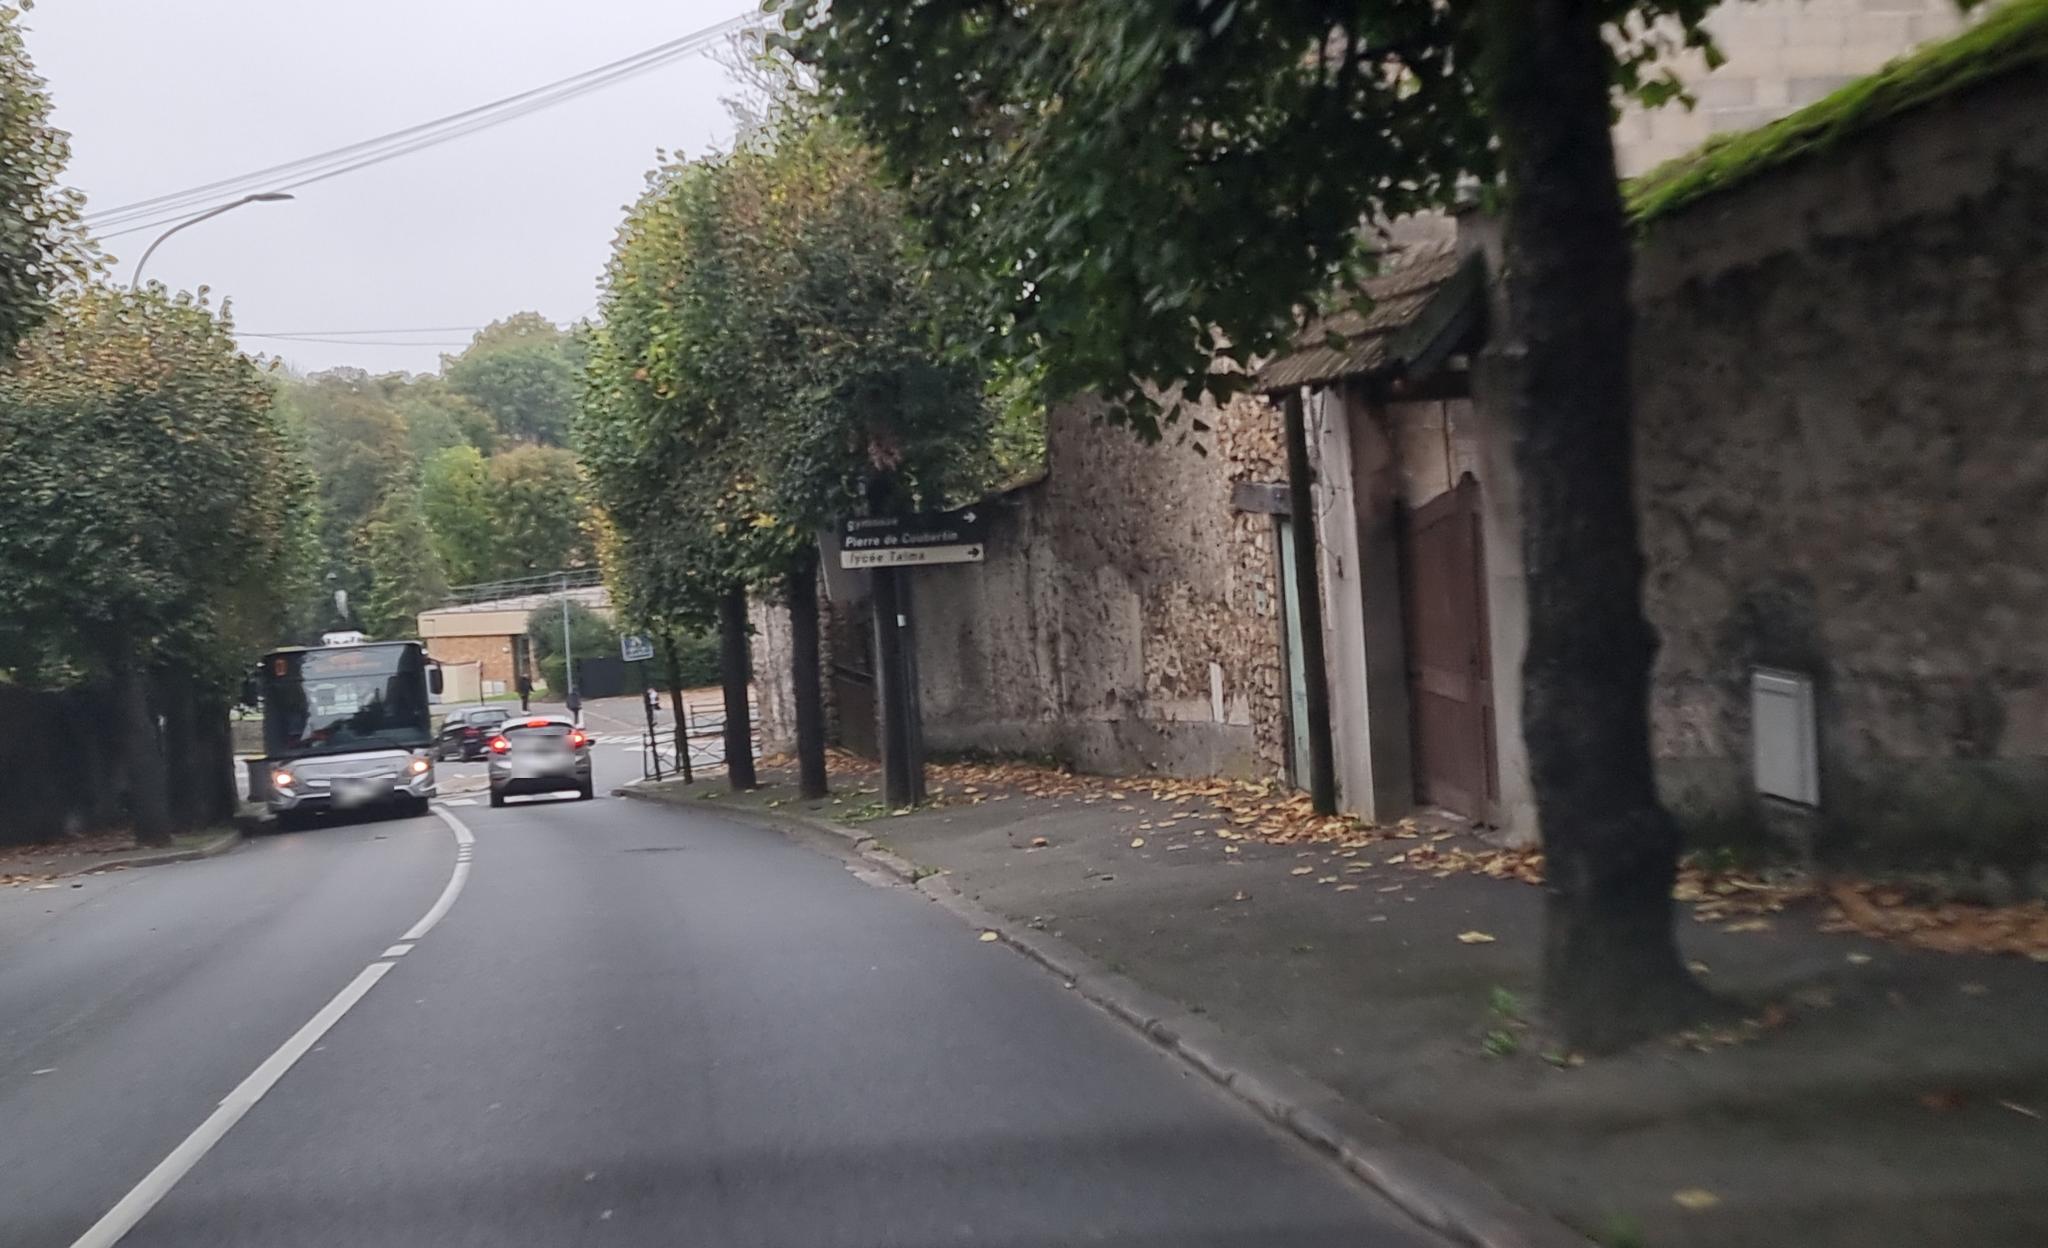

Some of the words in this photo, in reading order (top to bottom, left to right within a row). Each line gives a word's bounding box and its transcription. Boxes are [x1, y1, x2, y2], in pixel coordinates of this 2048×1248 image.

[845, 535, 880, 548] Pierre
[883, 535, 898, 545] de
[902, 531, 958, 544] Coubertin
